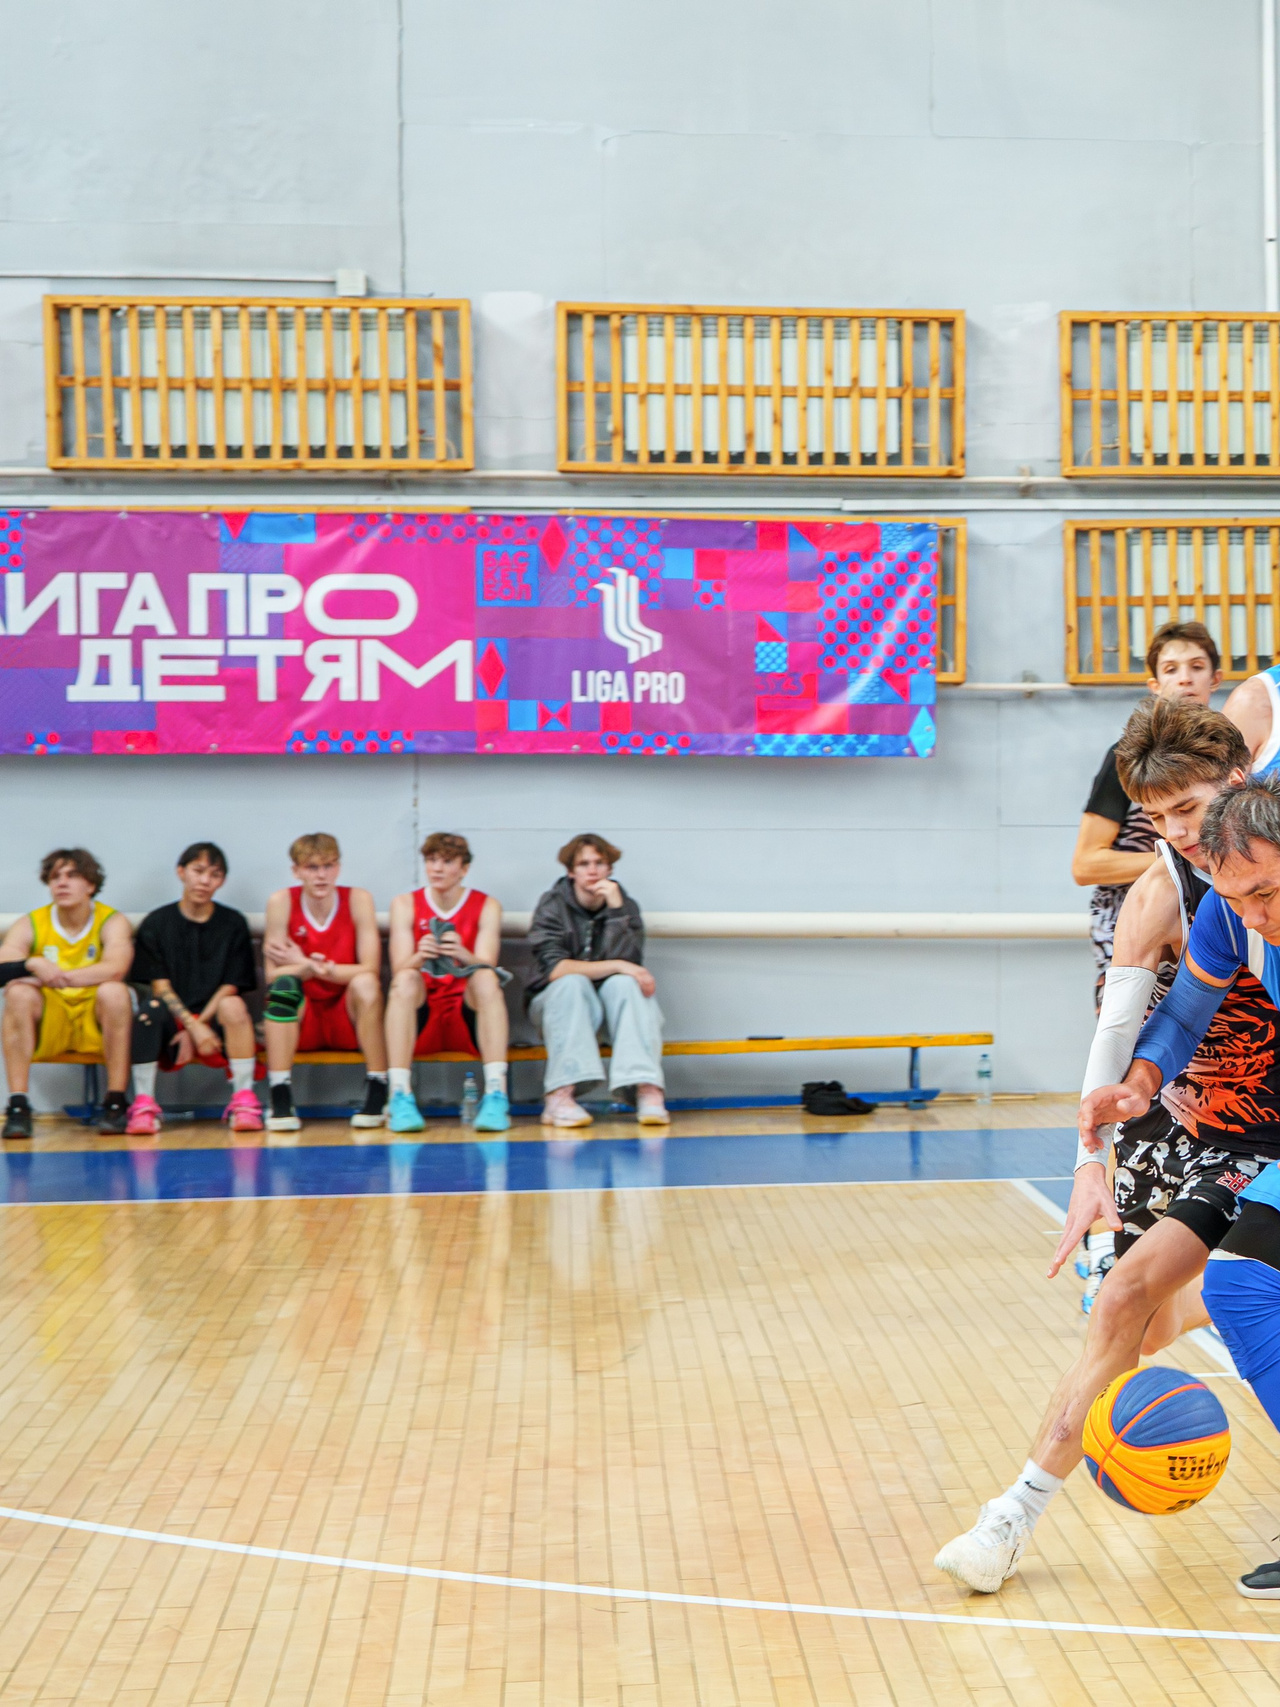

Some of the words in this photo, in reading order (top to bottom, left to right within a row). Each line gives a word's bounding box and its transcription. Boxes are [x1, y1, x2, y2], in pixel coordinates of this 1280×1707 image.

[0, 573, 177, 635] ИГА
[188, 573, 418, 636] ПРО
[67, 639, 473, 701] ДЕТЯМ
[571, 669, 630, 702] LIGA
[634, 671, 685, 704] PRO
